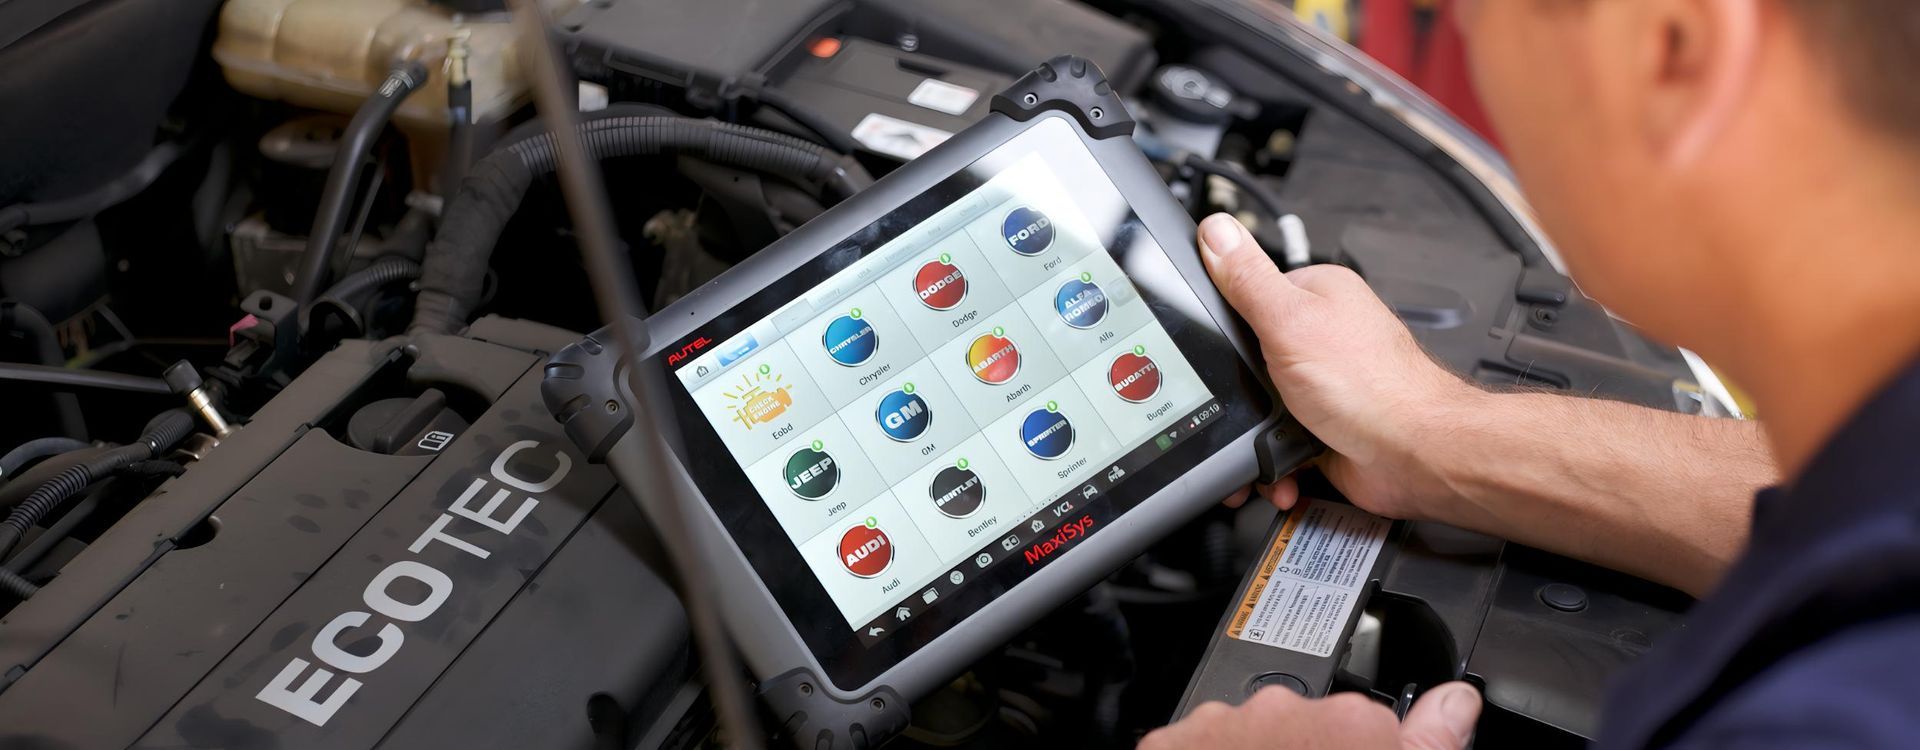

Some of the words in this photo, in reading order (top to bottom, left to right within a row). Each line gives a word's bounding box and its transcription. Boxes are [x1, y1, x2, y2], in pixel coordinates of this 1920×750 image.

[1008, 217, 1051, 248] FORD
[1044, 257, 1061, 271] Ford
[919, 269, 962, 301] DODGE
[1064, 289, 1091, 309] ALFA
[1064, 294, 1103, 321] ROMEO
[953, 310, 978, 328] Dodge
[829, 326, 873, 355] CHRYSLER
[1099, 330, 1115, 344] Alfa
[668, 336, 713, 366] AUTEL
[973, 344, 1015, 374] ABARTH
[859, 363, 892, 387] Chrysler
[1114, 362, 1156, 392] BUGATTI
[749, 396, 775, 413] CHECK
[1006, 384, 1032, 402] Abarth
[754, 401, 781, 420] ENGINE
[885, 400, 923, 430] GM
[1147, 401, 1174, 422] Bugatti
[772, 423, 794, 440] Eobd
[1027, 418, 1068, 448] SPRINTER
[922, 444, 936, 456] GM
[791, 457, 832, 490] JEEP
[1057, 457, 1088, 479] Sprinter
[936, 475, 979, 508] BENTLEY
[828, 501, 847, 516] Jeep
[968, 515, 997, 538] Bentley
[847, 535, 885, 566] AUDI
[1025, 514, 1094, 565] MaxiSys
[882, 578, 901, 594] Audi
